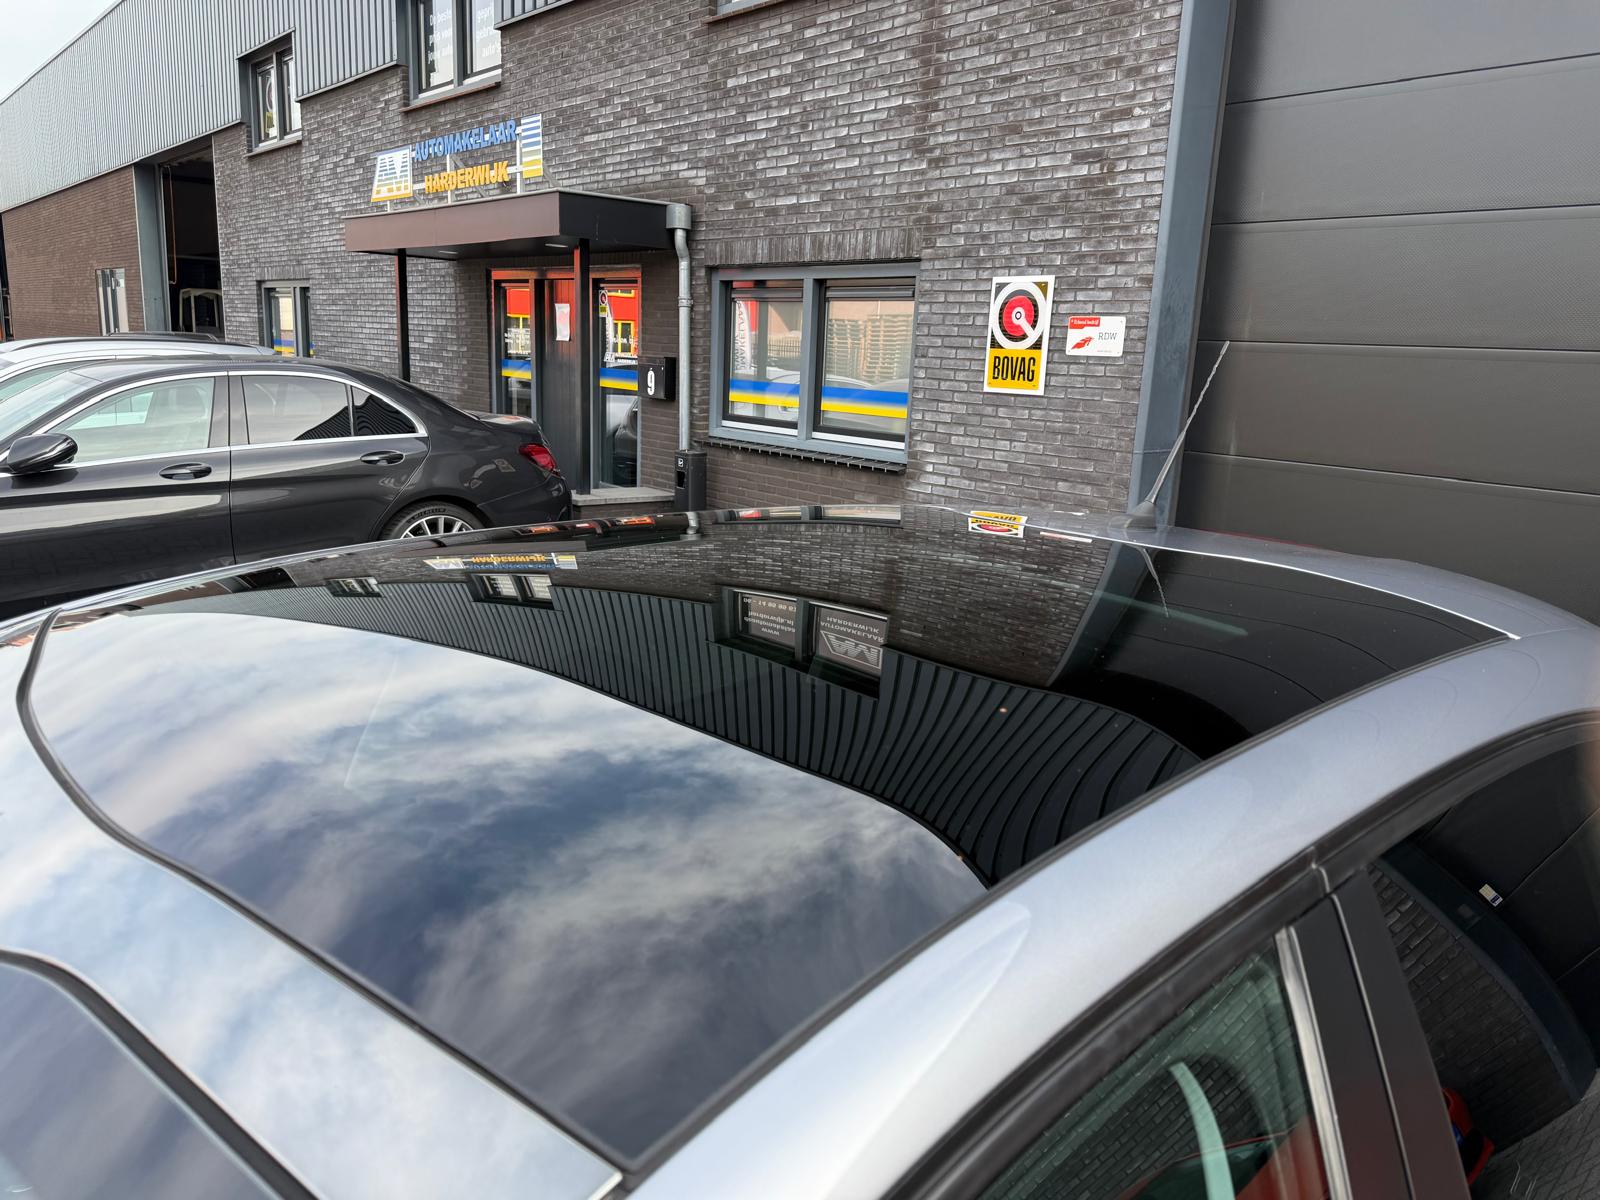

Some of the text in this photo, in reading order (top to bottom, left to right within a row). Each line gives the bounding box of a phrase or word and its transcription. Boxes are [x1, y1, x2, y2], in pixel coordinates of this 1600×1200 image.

[414, 120, 517, 162] AUTOMAKELAAR
[425, 161, 510, 193] HARDERWIJK
[1098, 332, 1118, 341] RDW
[992, 355, 1036, 382] BOVAG
[647, 370, 655, 395] 9
